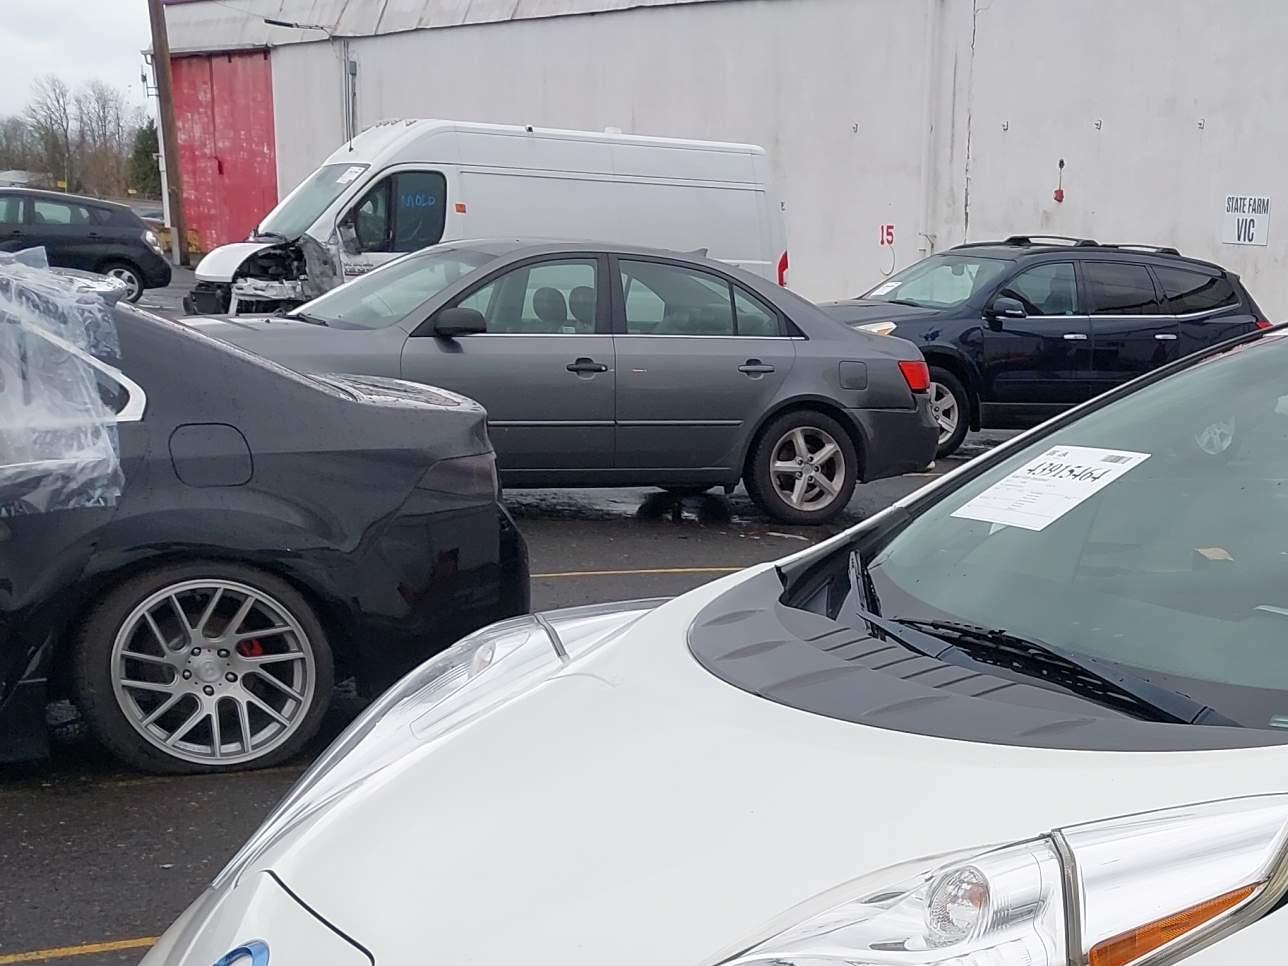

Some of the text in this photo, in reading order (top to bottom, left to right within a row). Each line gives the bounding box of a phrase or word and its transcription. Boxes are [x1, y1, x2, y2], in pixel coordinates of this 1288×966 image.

[1227, 197, 1269, 214] STATE FARM
[880, 225, 894, 245] 15
[1236, 218, 1255, 242] VIC
[1027, 461, 1113, 482] 43915464
